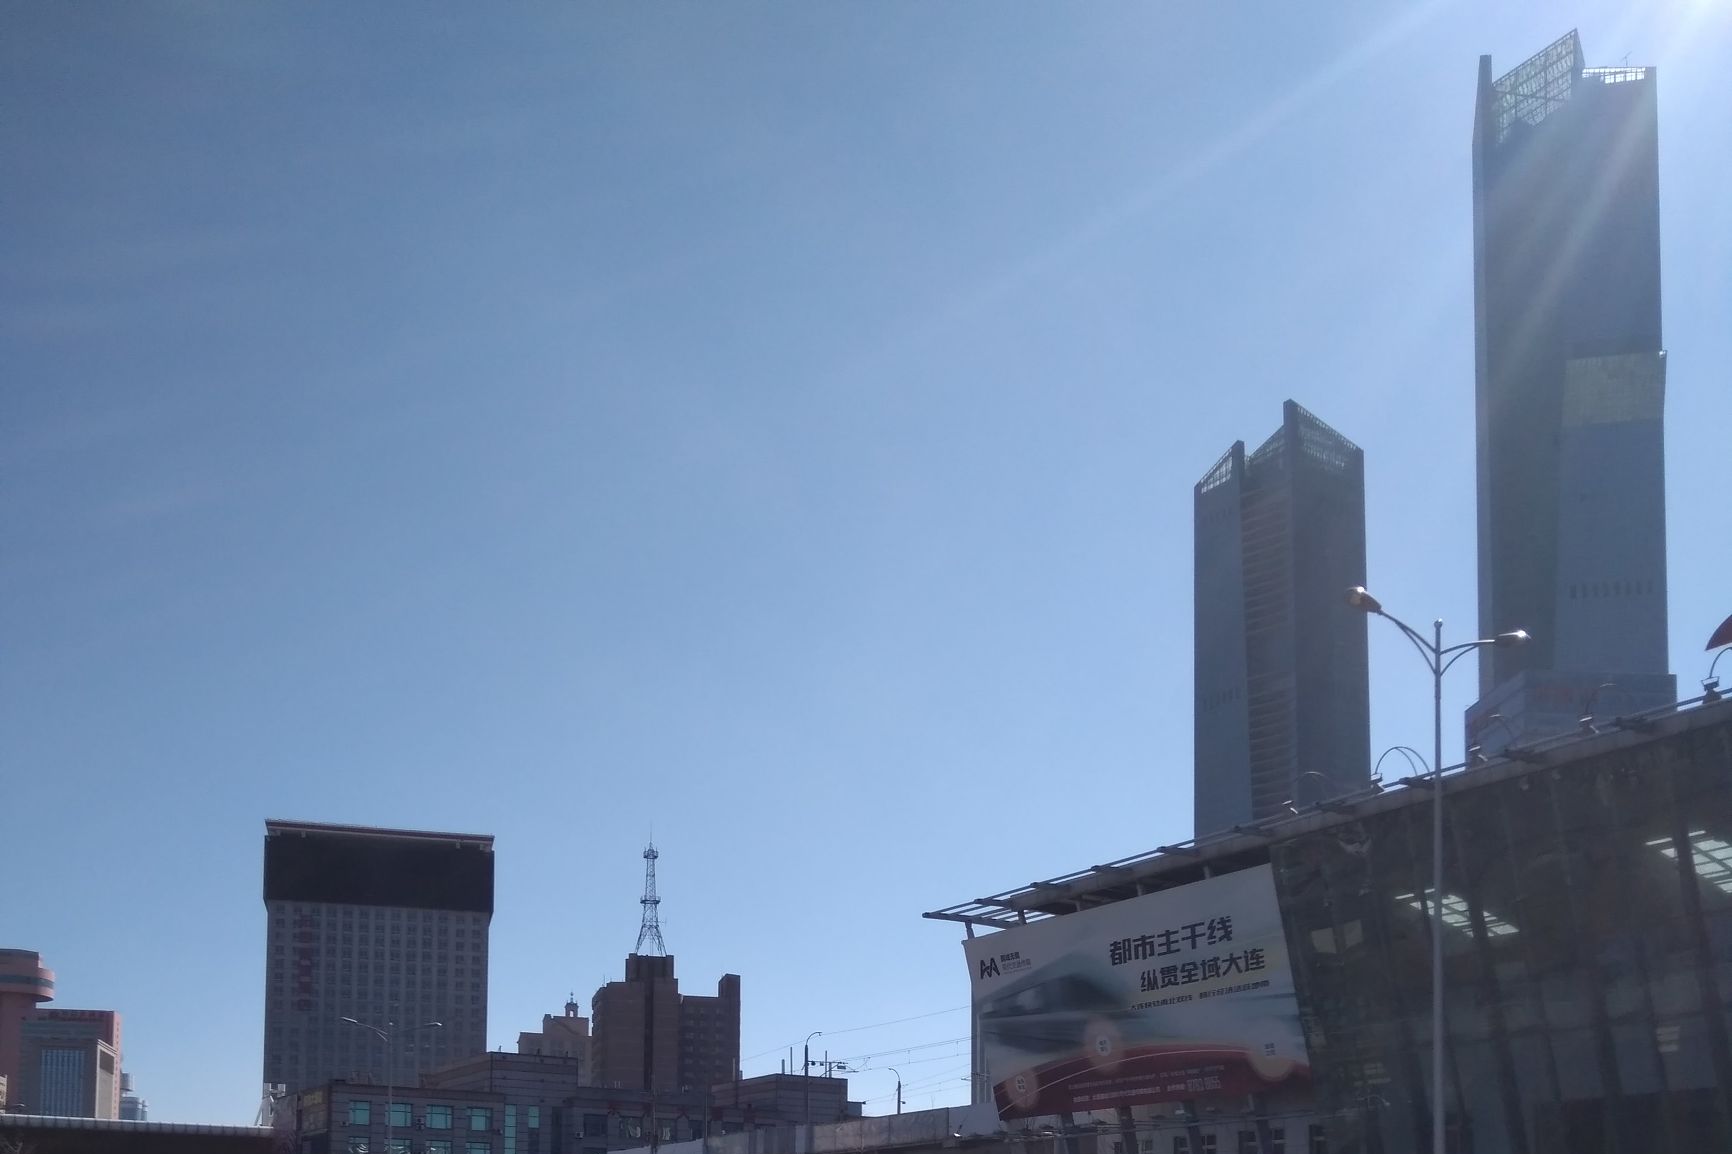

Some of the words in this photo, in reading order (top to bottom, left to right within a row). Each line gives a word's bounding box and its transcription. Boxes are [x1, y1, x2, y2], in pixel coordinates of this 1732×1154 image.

[1109, 915, 1233, 966] 都市主干线
[1140, 948, 1265, 992] 纵贯全域大连
